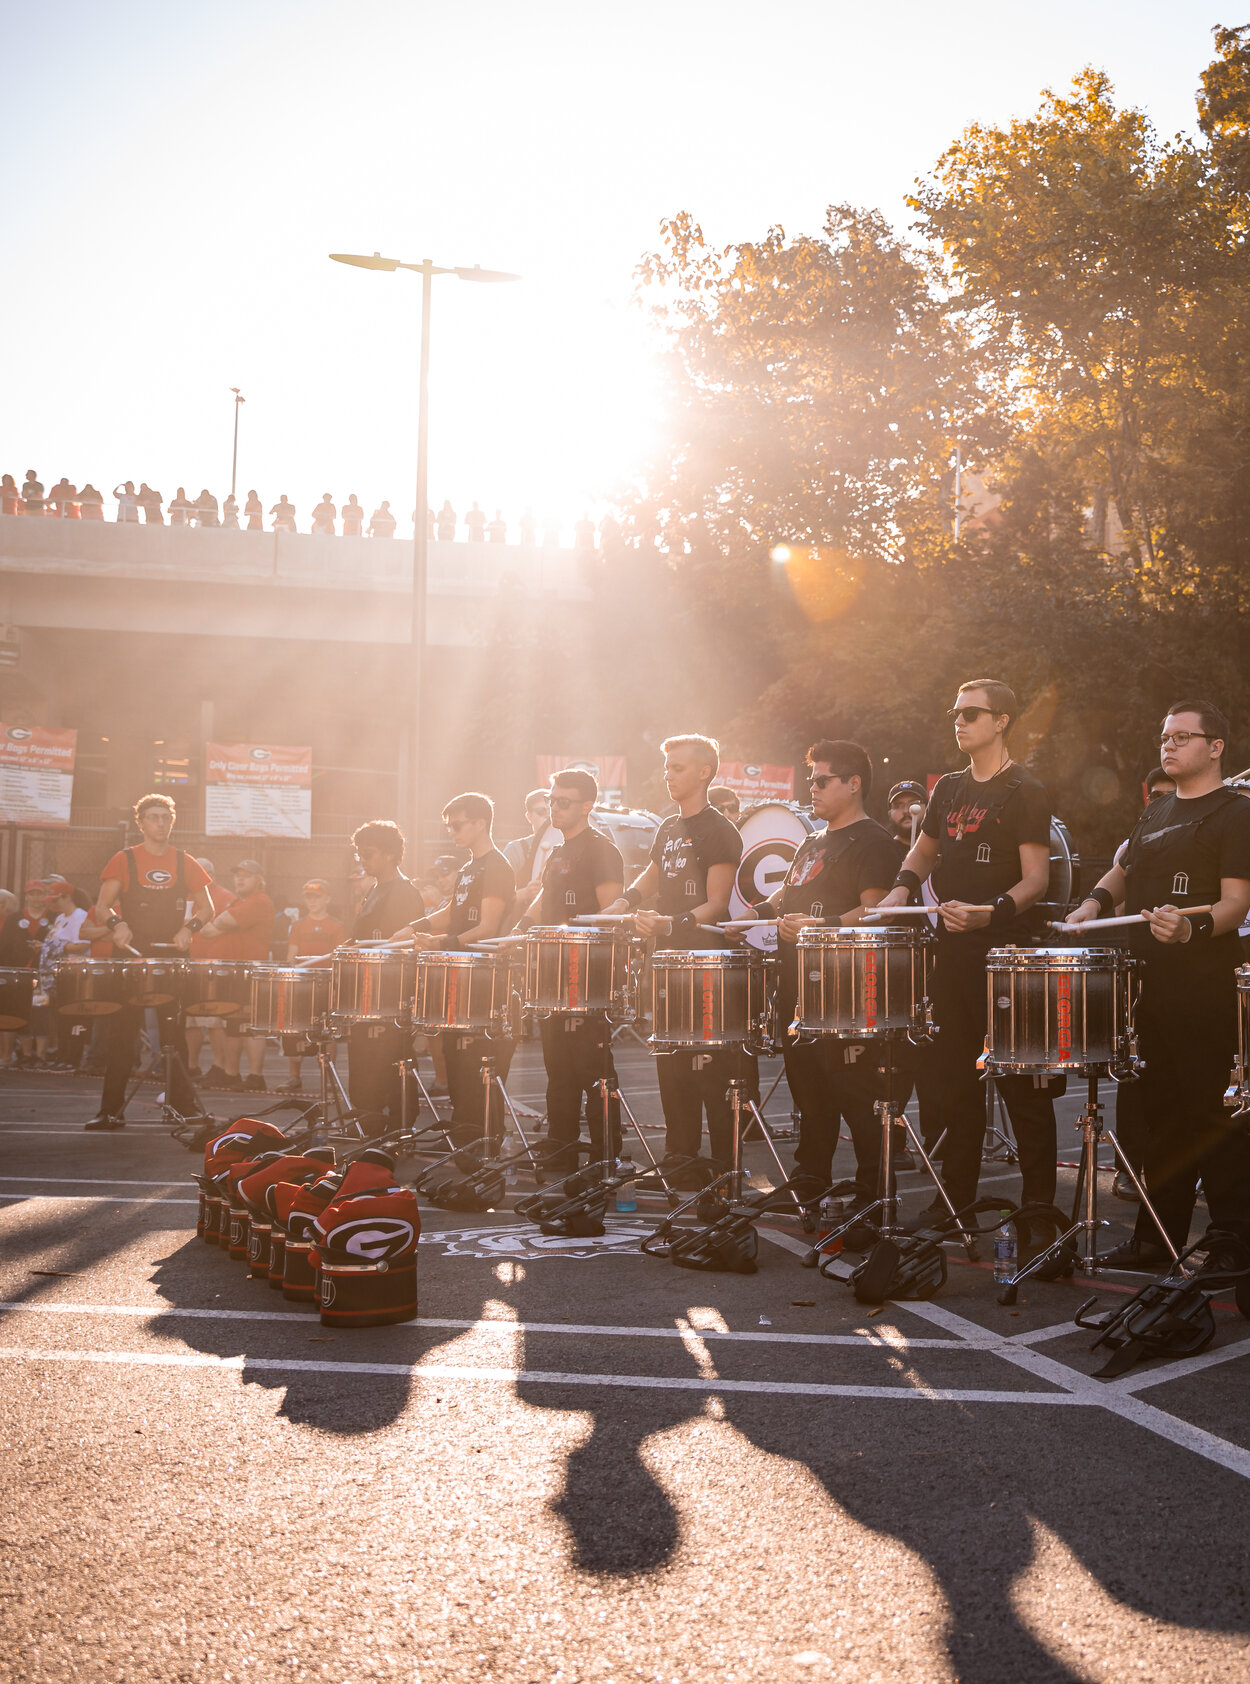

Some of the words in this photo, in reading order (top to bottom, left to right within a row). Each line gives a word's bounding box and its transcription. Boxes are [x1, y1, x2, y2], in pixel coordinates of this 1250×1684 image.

[29, 744, 73, 757] Permitted
[270, 763, 309, 773] Permitted
[760, 780, 791, 790] Permitted
[568, 945, 580, 1008] GEORGIA
[703, 971, 714, 1040] GEORGIA
[865, 951, 878, 1028] GEORGIA
[1057, 974, 1072, 1062] GEORGIA
